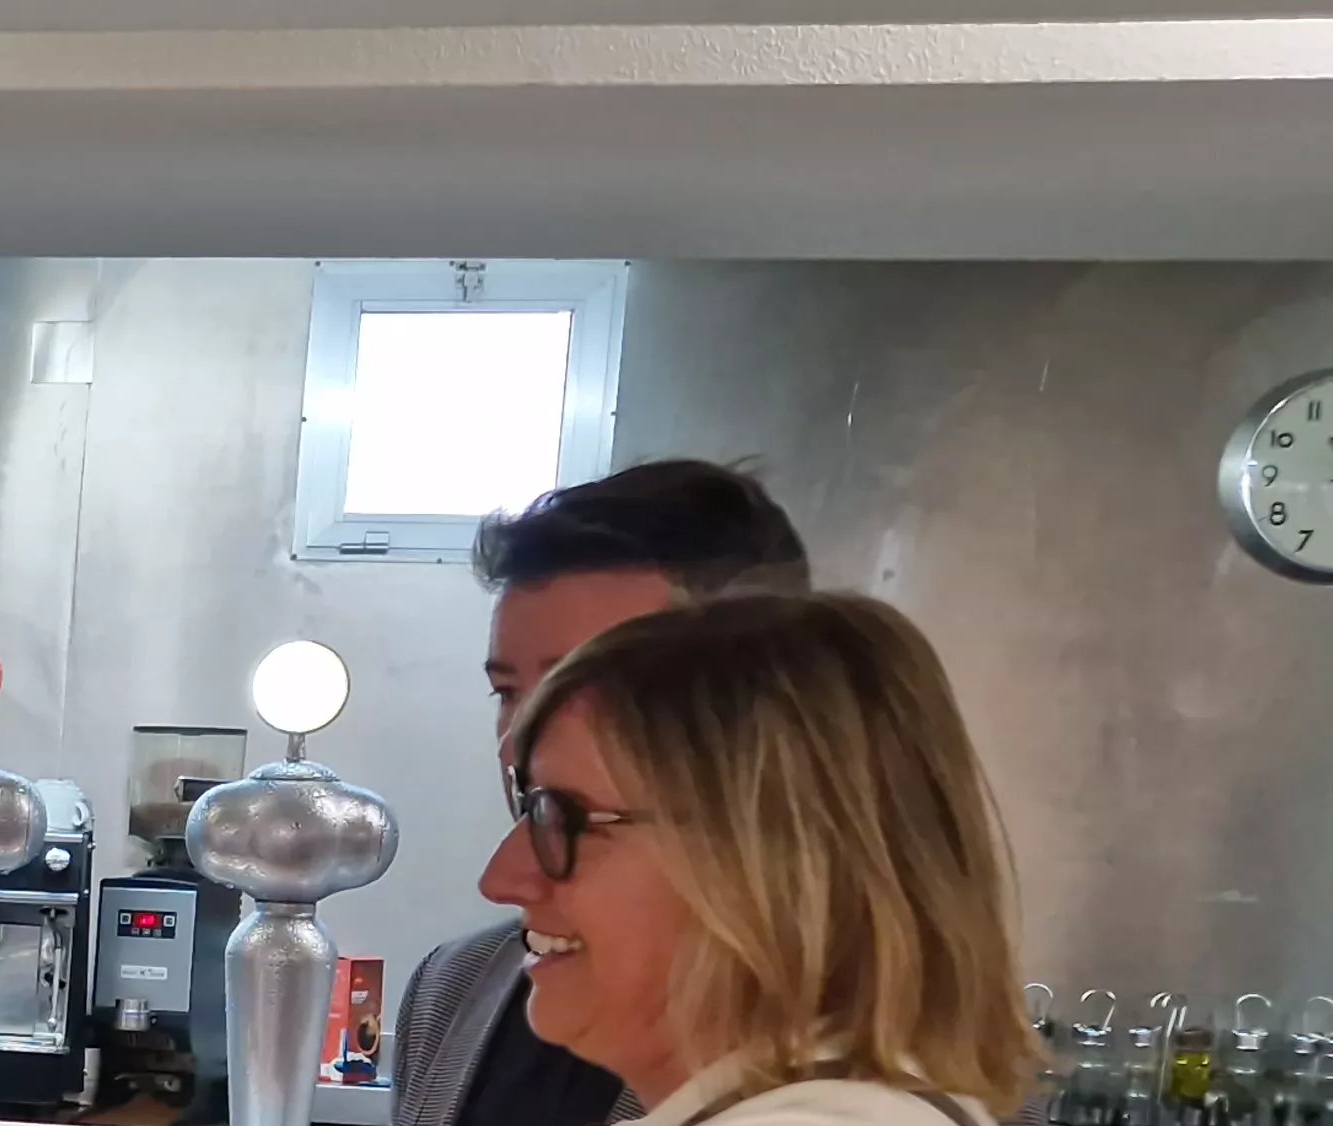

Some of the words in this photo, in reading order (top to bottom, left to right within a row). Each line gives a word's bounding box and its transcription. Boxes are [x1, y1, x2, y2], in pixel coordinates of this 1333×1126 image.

[1307, 401, 1321, 421] 11
[1270, 430, 1294, 448] 10
[1261, 464, 1279, 488] 9
[1269, 501, 1287, 526] 8
[1294, 528, 1315, 553] 7
